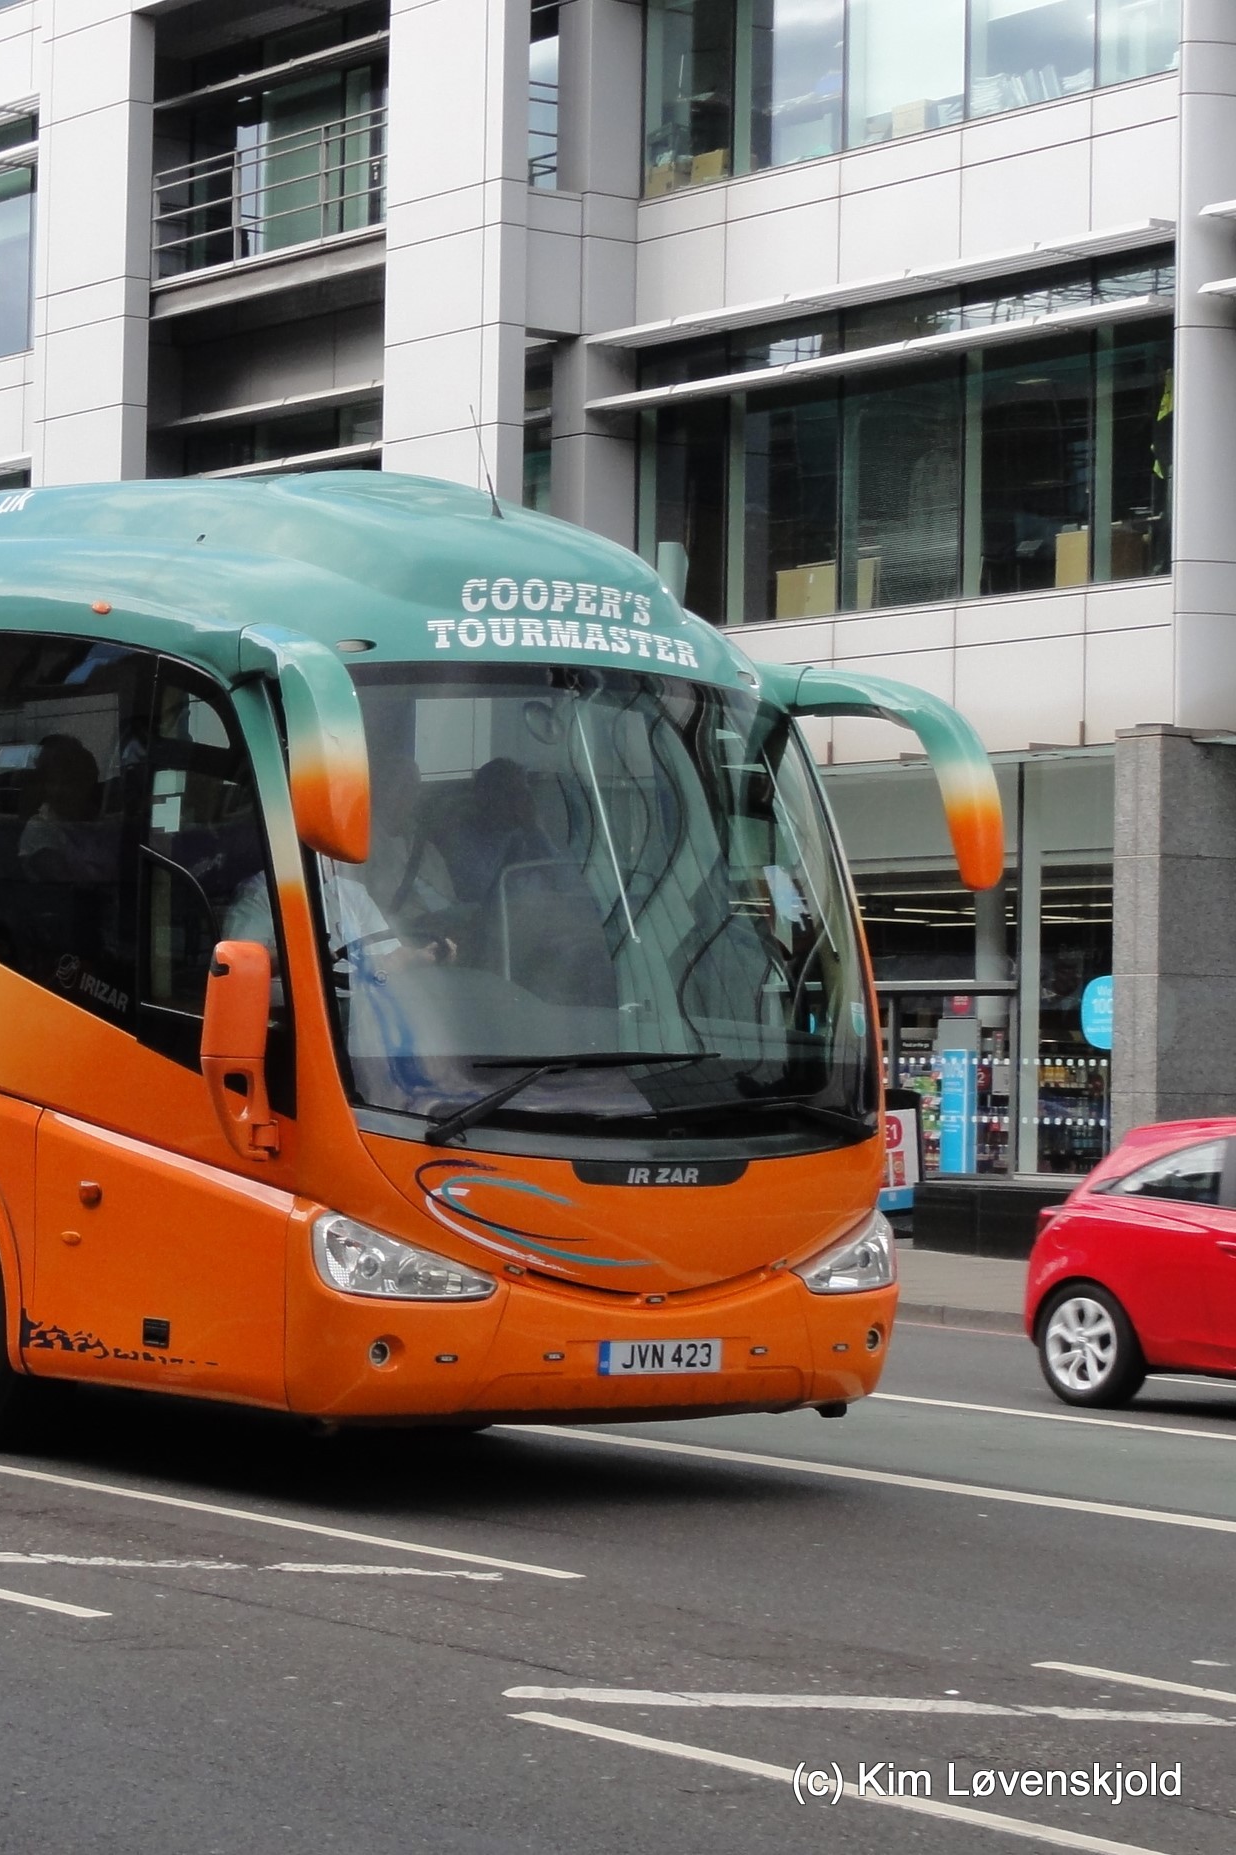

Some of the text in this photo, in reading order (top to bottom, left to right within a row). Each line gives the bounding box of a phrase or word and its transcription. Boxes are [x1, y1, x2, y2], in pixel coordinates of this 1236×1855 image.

[461, 577, 652, 626] COOPER'S
[426, 617, 700, 669] TOURMASTER
[79, 972, 129, 1012] IRIZAR
[622, 1342, 712, 1369] JVN 423
